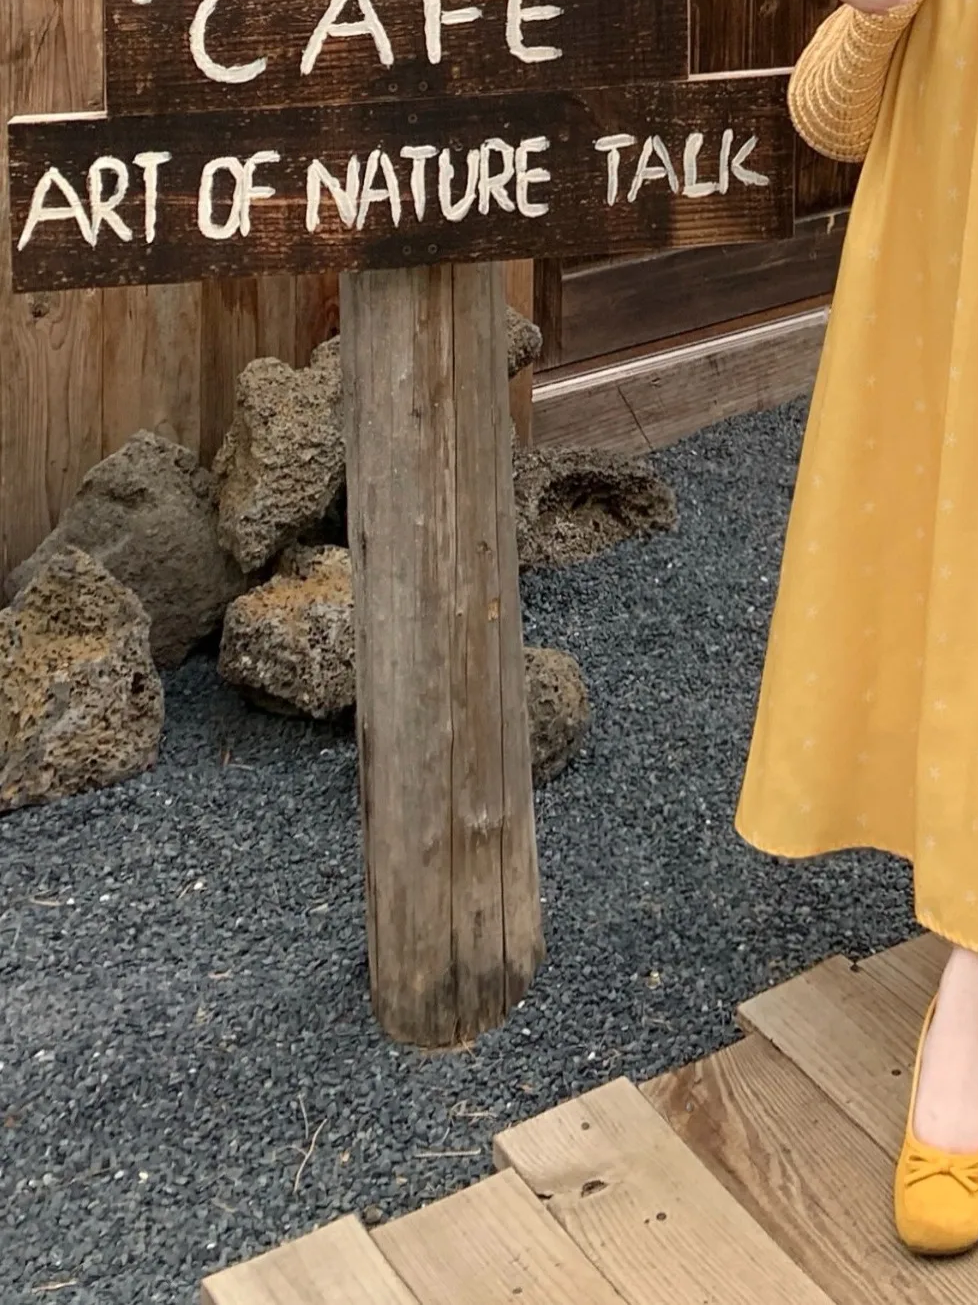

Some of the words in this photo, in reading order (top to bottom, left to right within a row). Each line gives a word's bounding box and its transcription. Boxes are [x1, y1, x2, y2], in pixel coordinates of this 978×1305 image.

[17, 151, 172, 251] ART
[197, 150, 281, 239] OF
[305, 136, 551, 233] NATURE
[595, 128, 769, 206] TALK
